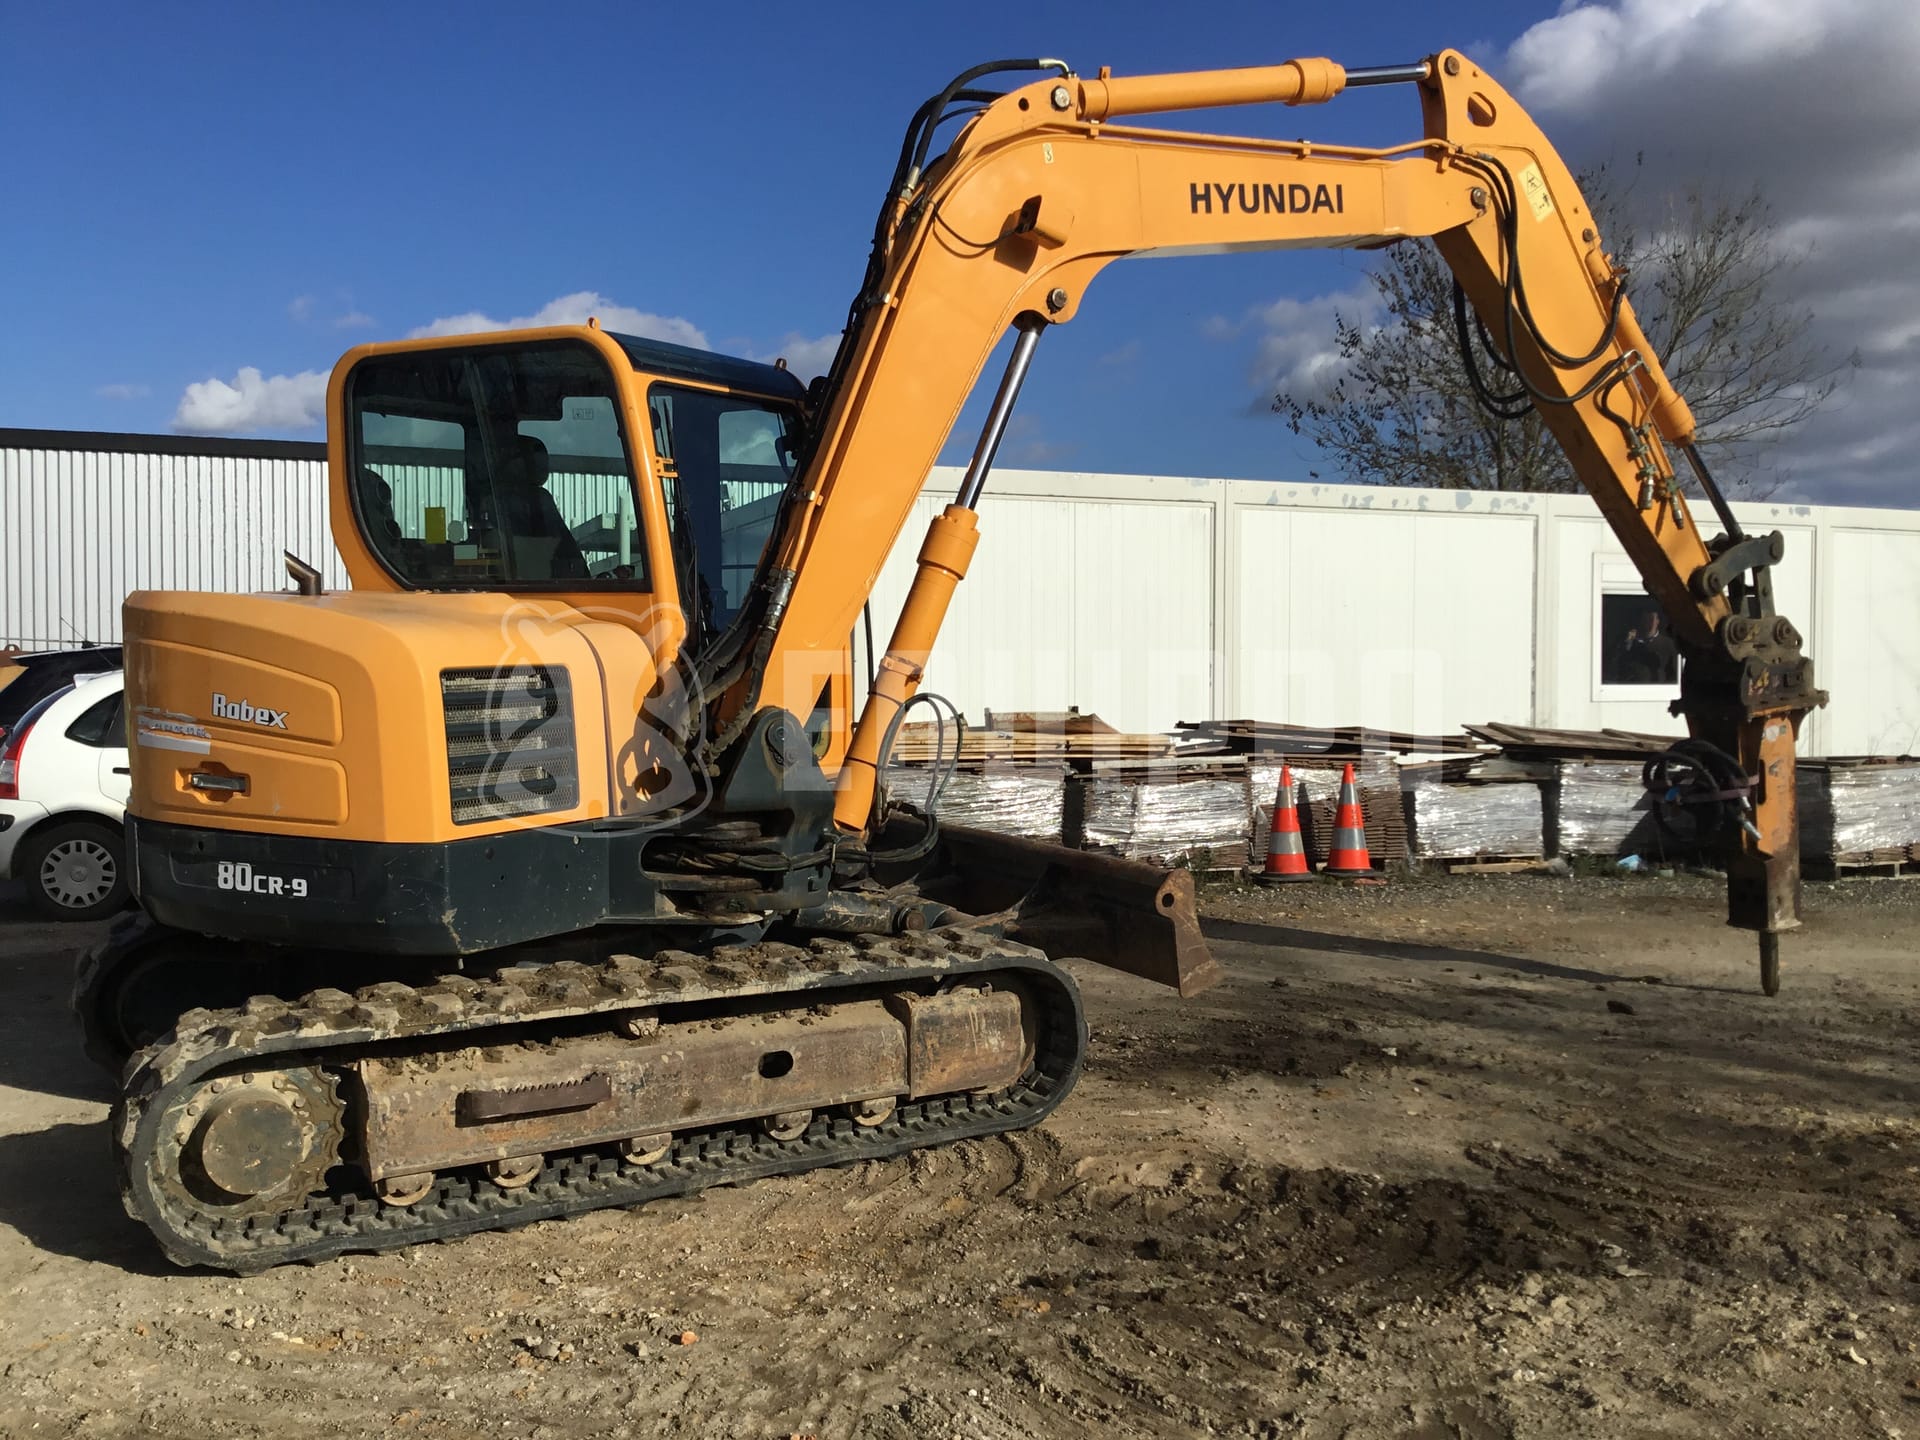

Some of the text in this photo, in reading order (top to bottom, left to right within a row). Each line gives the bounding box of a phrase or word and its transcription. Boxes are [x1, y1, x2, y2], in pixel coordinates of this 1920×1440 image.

[1189, 183, 1344, 214] HYUNDAI
[212, 692, 289, 730] Robex
[217, 861, 308, 897] 80CR-9
